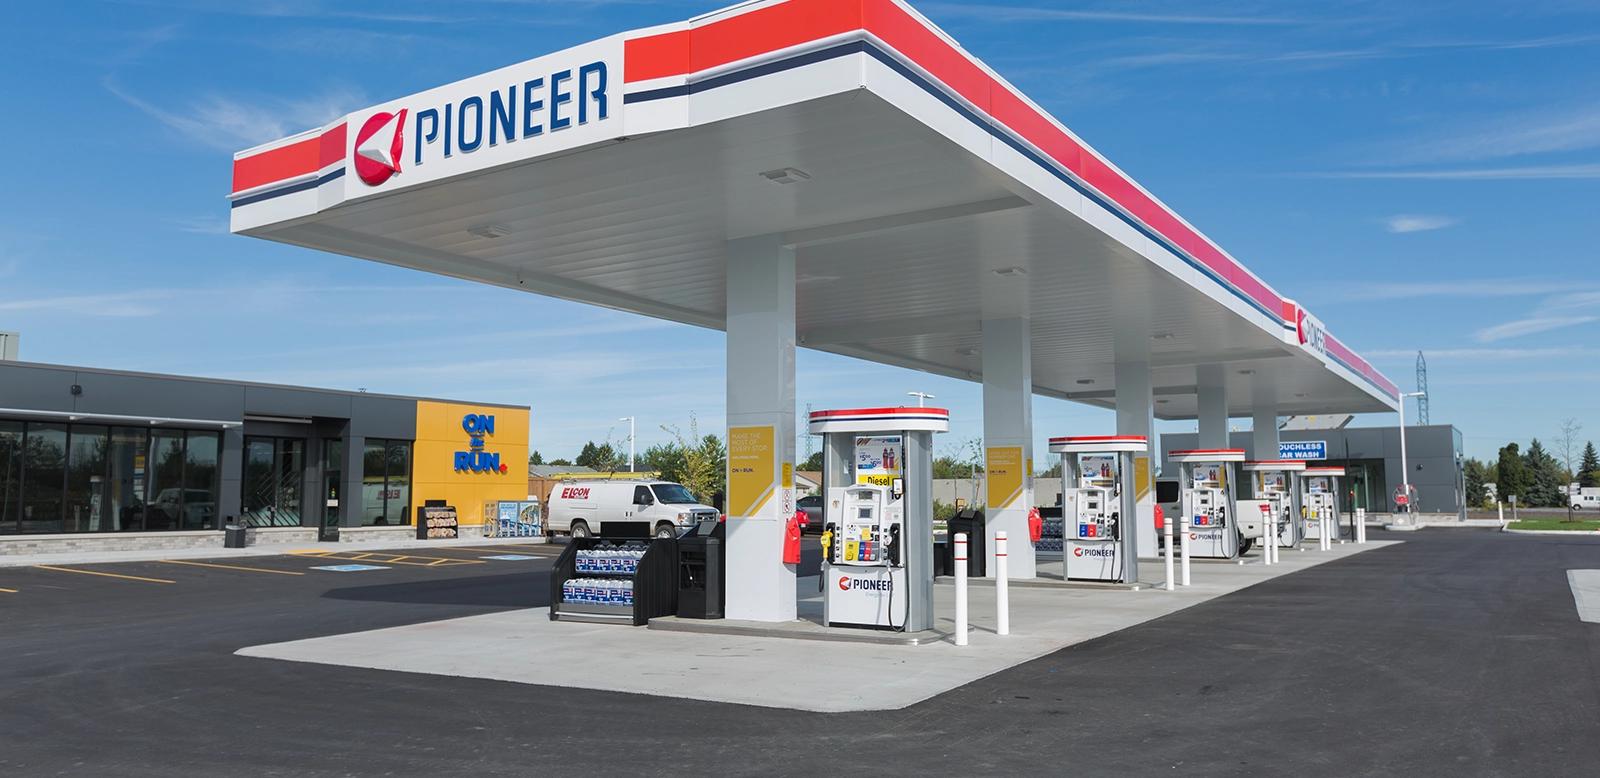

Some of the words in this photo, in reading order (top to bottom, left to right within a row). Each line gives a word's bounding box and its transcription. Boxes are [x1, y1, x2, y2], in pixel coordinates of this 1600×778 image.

[415, 60, 609, 165] PIONEER
[462, 413, 495, 434] ON
[1280, 443, 1322, 451] OUCHLESS
[454, 451, 500, 473] RUN
[867, 476, 890, 486] Diesel
[561, 487, 591, 500] ELCON
